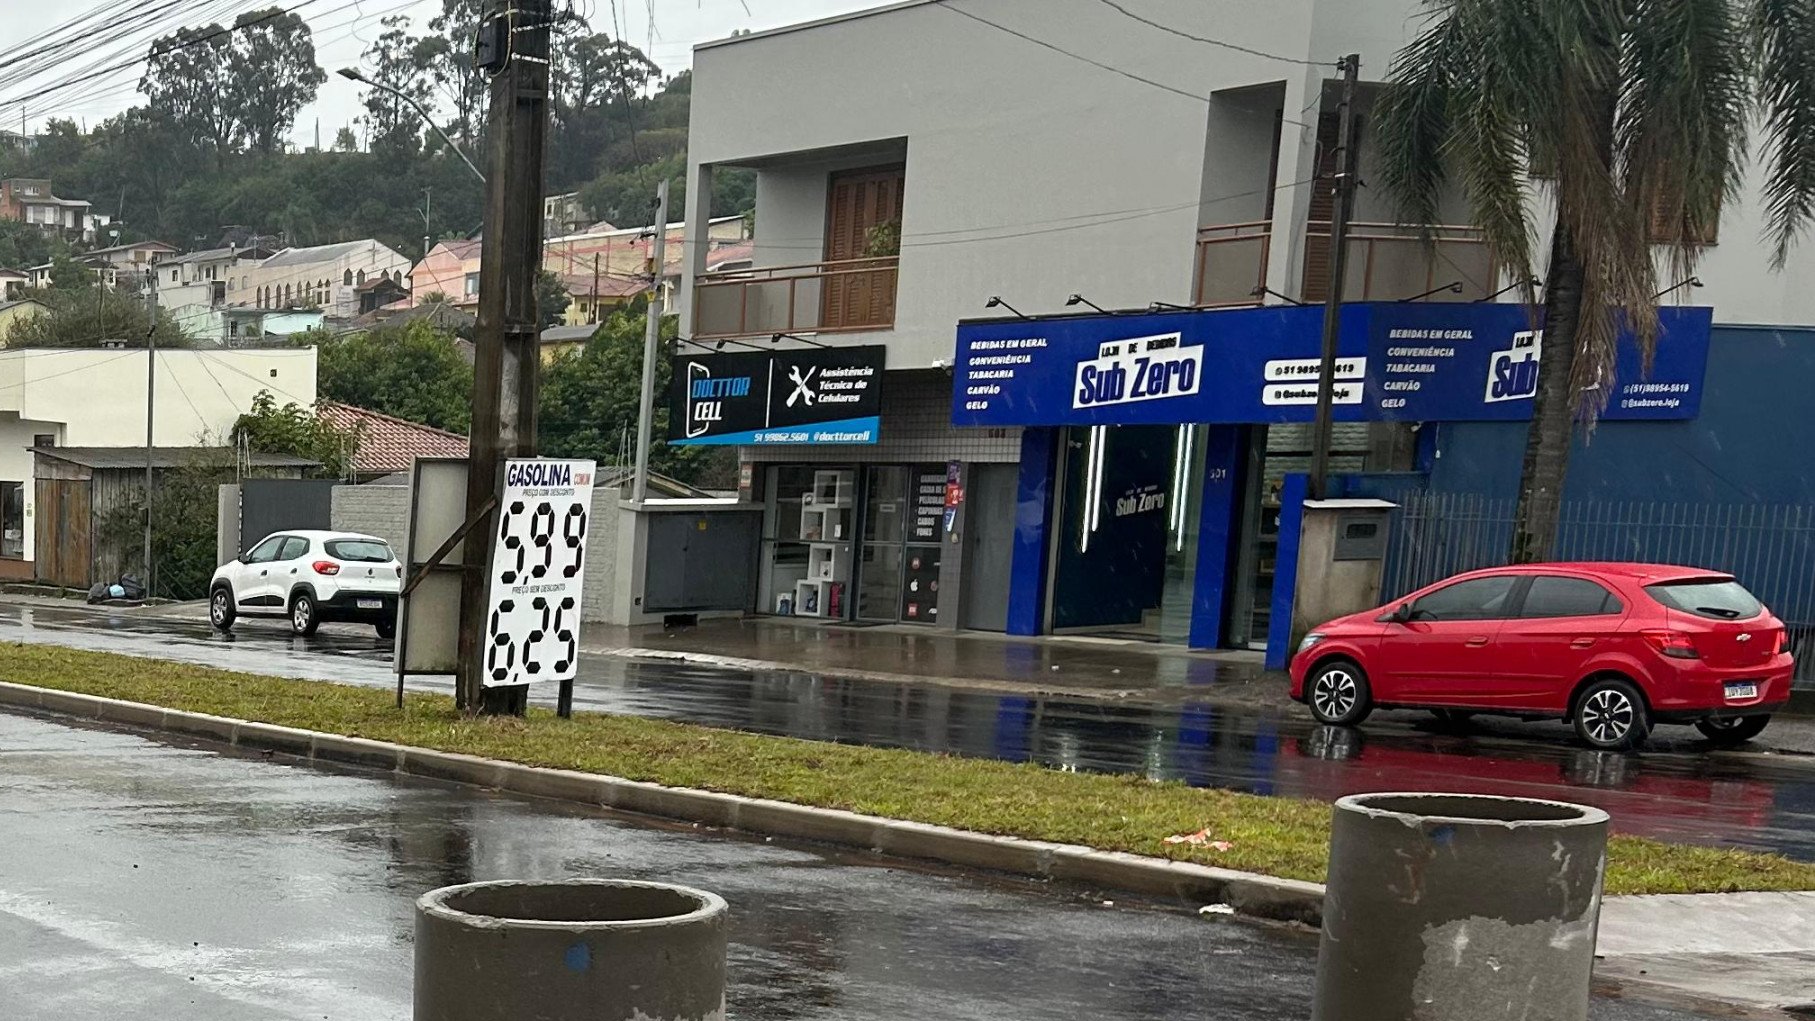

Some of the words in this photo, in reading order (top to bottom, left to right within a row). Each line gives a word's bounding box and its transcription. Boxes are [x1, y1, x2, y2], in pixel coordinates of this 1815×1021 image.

[1390, 329, 1428, 339] BEBIDAS
[1444, 330, 1472, 339] GERAL
[971, 340, 1005, 350] BEBIDAS
[1020, 338, 1047, 348] GERAL
[1128, 342, 1139, 354] DE
[819, 366, 874, 378] Assistência
[1386, 363, 1435, 373] TABACARIA
[969, 370, 1014, 380] TABACARIA
[1079, 361, 1126, 405] Sub
[1130, 356, 1196, 398] Zero
[1491, 352, 1539, 399] Sub
[692, 377, 751, 398] DOCTTOR
[819, 381, 853, 390] Técnica
[854, 380, 868, 389] de
[967, 384, 1001, 395] CARVÃO
[1384, 380, 1421, 391] CARVÃO
[818, 394, 861, 403] Celulares
[1381, 398, 1406, 408] GELO
[694, 401, 722, 421] CELL
[966, 401, 988, 410] GELO
[507, 464, 571, 487] GASOLINA
[1116, 496, 1137, 517] Sub
[1137, 493, 1165, 513] Zero
